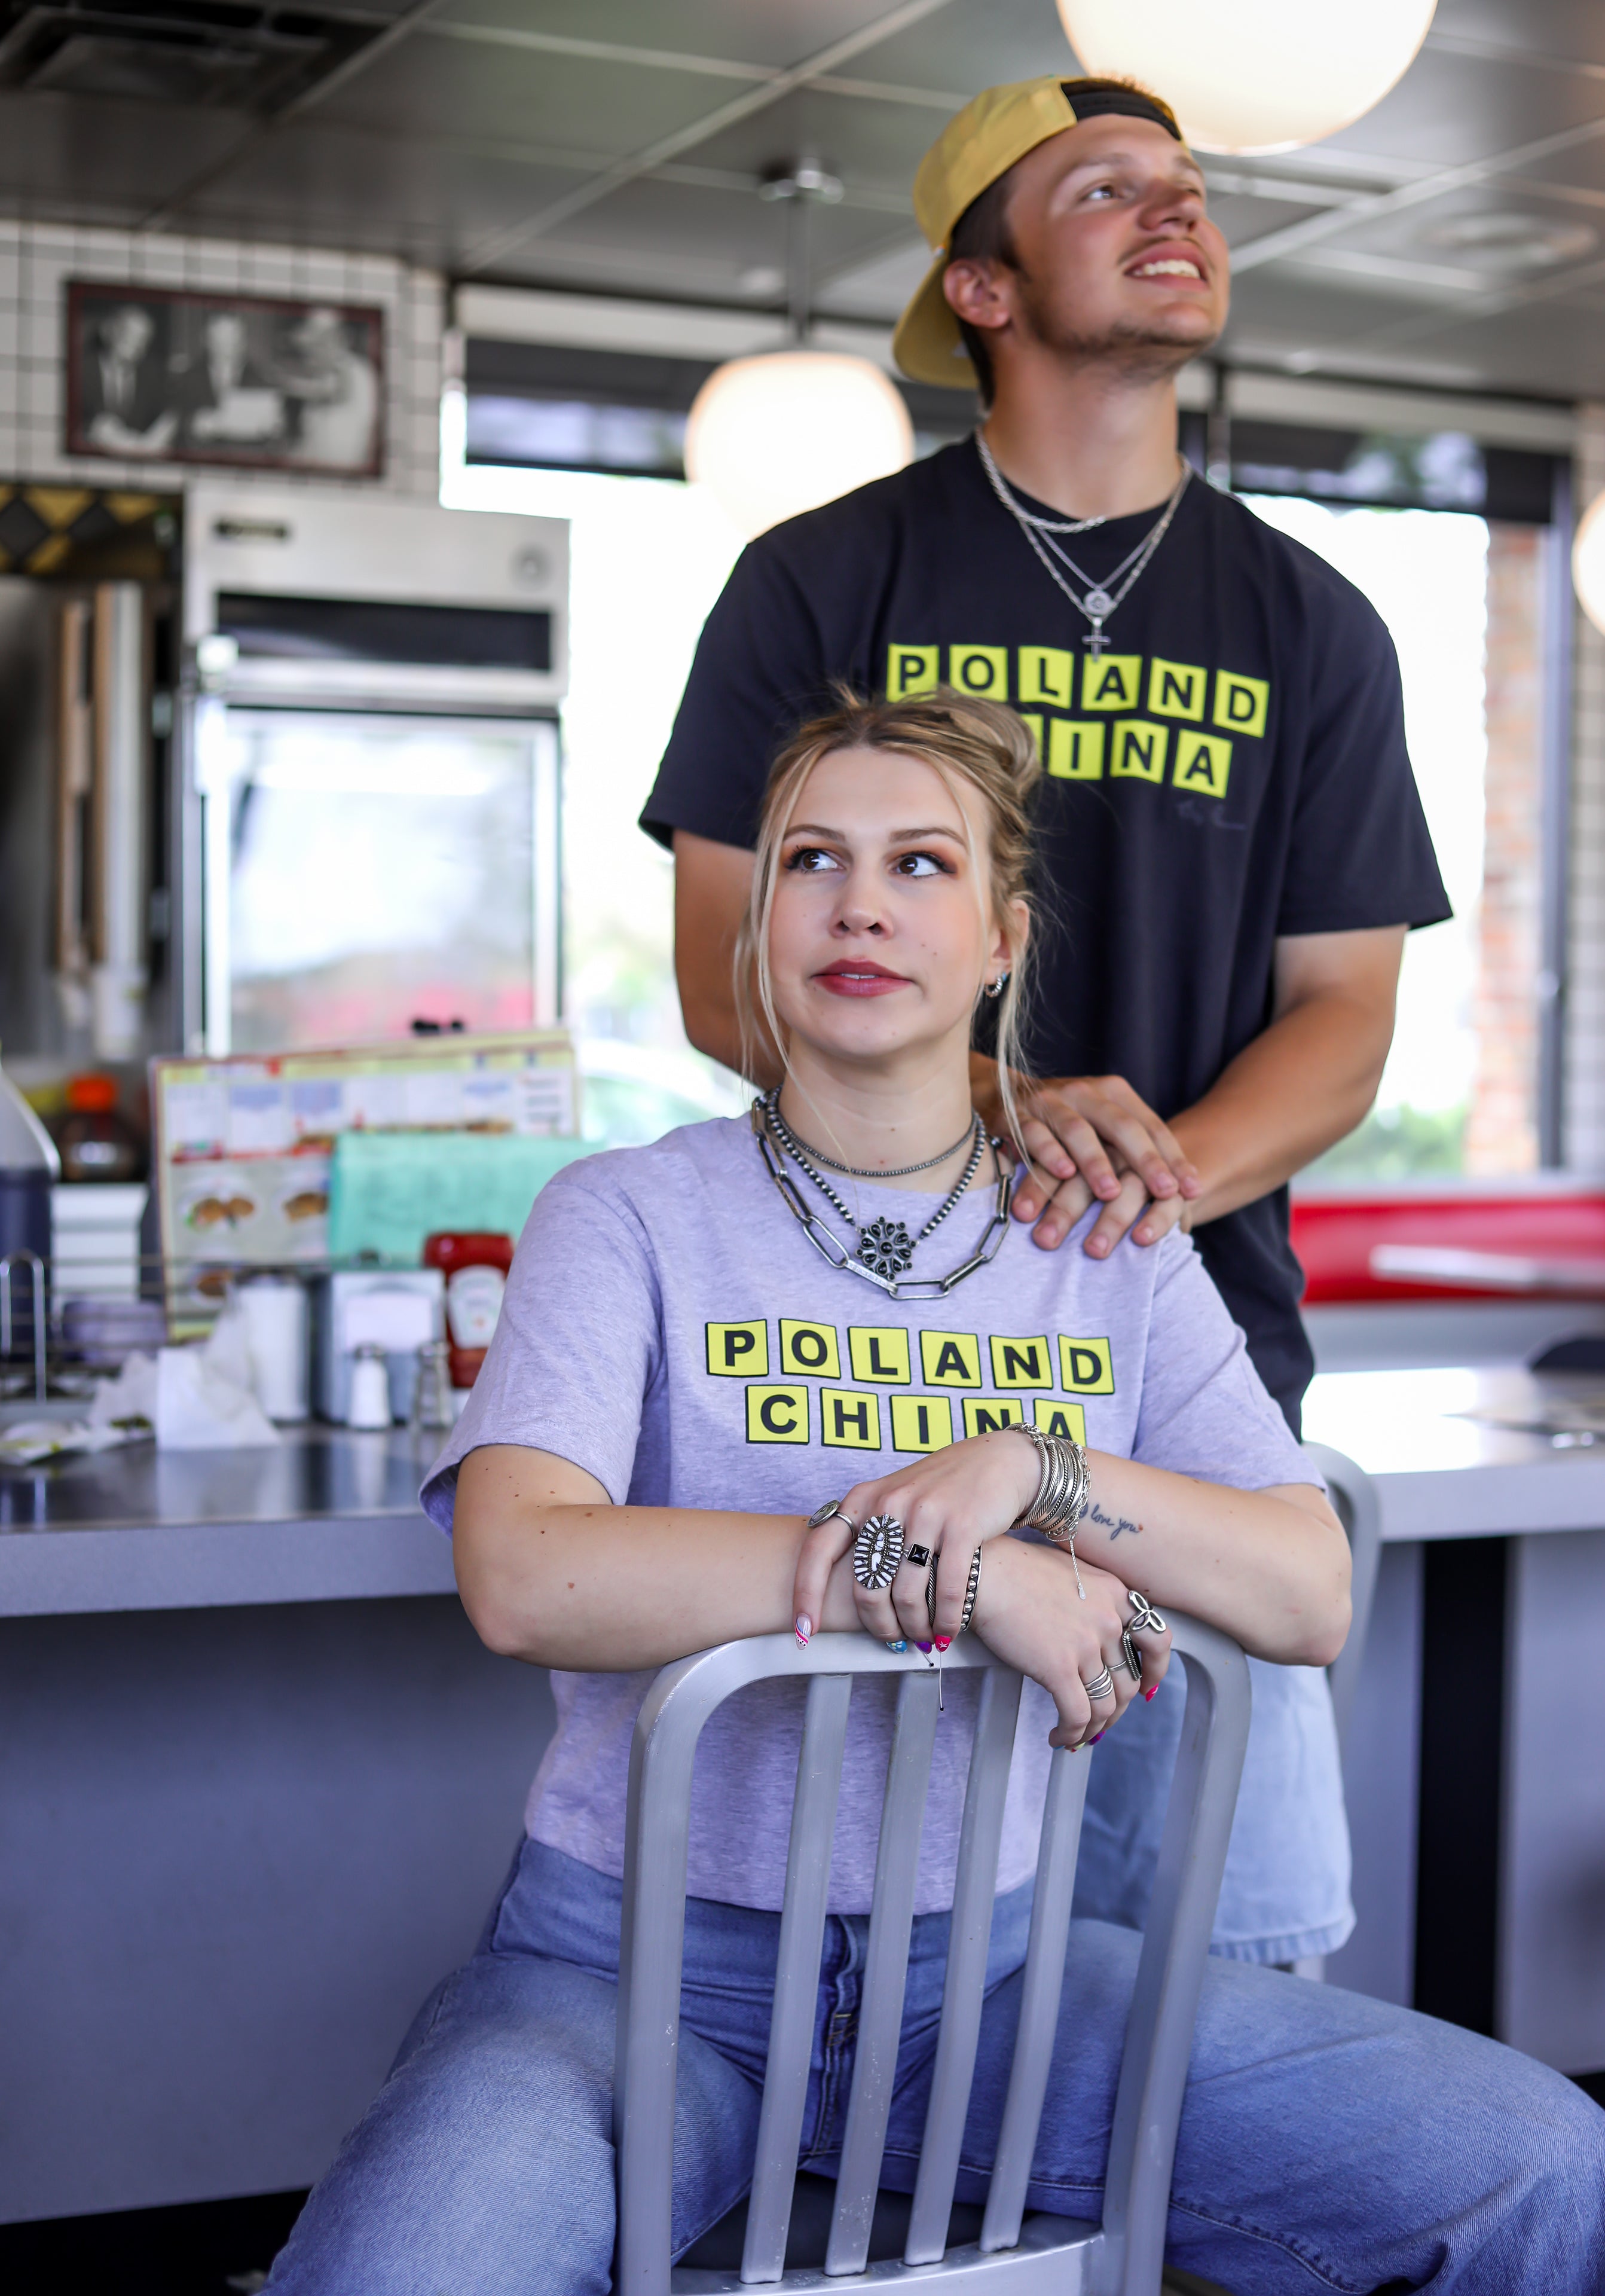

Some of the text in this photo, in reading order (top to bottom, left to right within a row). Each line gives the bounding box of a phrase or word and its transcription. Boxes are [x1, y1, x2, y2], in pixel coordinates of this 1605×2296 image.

[899, 654, 1256, 722] POLAND
[1071, 732, 1216, 786] INA
[723, 1330, 1103, 1385] POLAND
[760, 1394, 1074, 1444] CHINA
[1090, 1503, 1115, 1526] love
[1110, 1518, 1139, 1541] you
